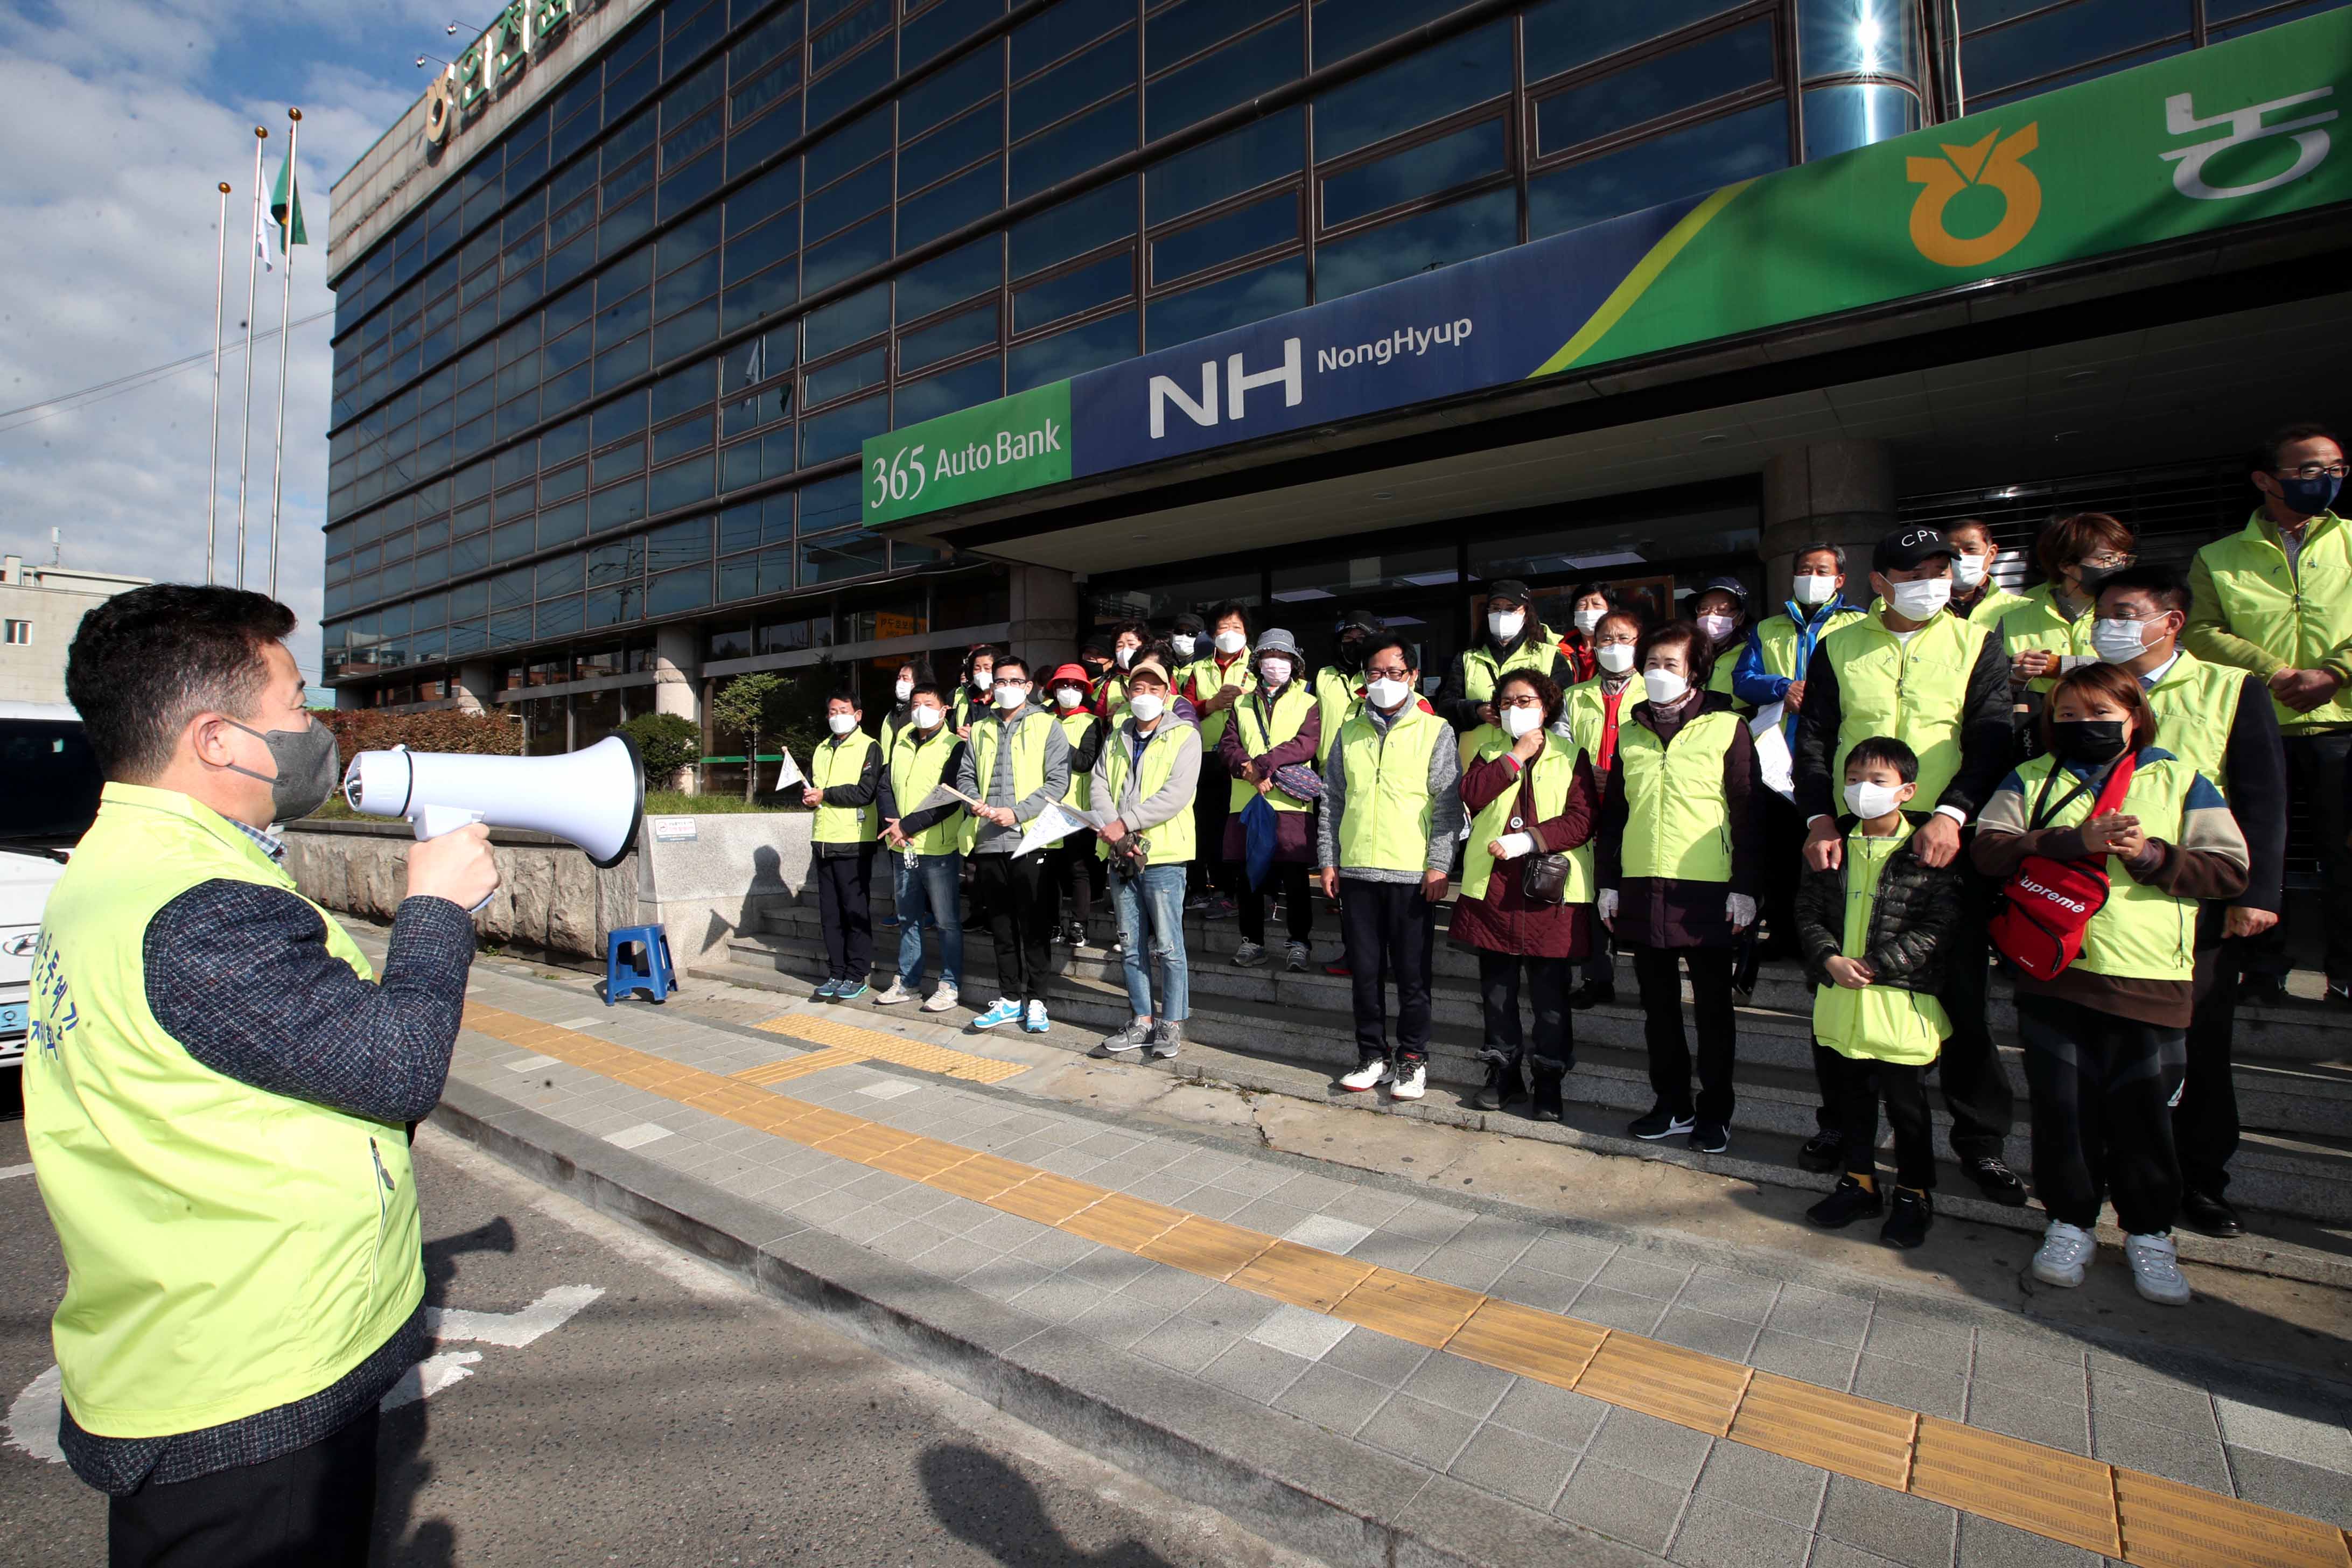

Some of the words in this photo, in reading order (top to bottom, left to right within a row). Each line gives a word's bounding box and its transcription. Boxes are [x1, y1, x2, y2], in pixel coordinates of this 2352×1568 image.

[2158, 86, 2339, 199] 농
[1149, 338, 1303, 439] NH
[1318, 318, 1473, 373] NongHyup
[871, 444, 926, 508] 365
[934, 442, 991, 481] Auto
[997, 418, 1061, 465] Bank
[1901, 530, 1939, 547] CPT
[2019, 876, 2085, 913] upreme
